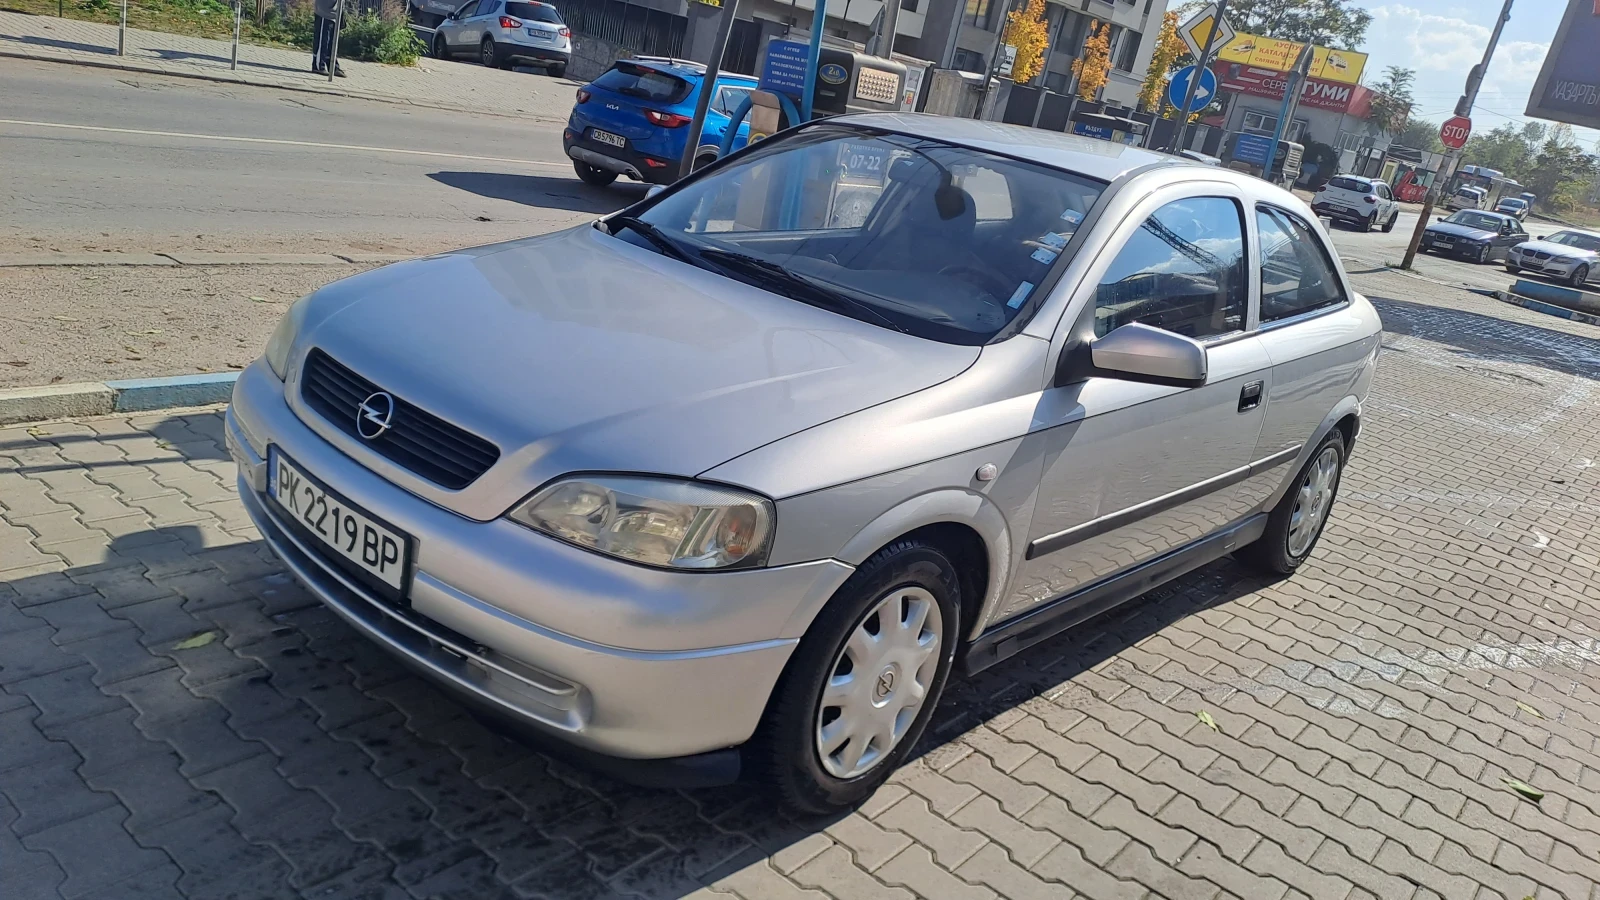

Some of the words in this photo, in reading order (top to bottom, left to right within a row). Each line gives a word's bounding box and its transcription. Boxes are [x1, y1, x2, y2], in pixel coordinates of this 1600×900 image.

[1301, 80, 1350, 103] ГУМИ
[1443, 124, 1469, 140] STOP
[850, 153, 881, 171] 07-22
